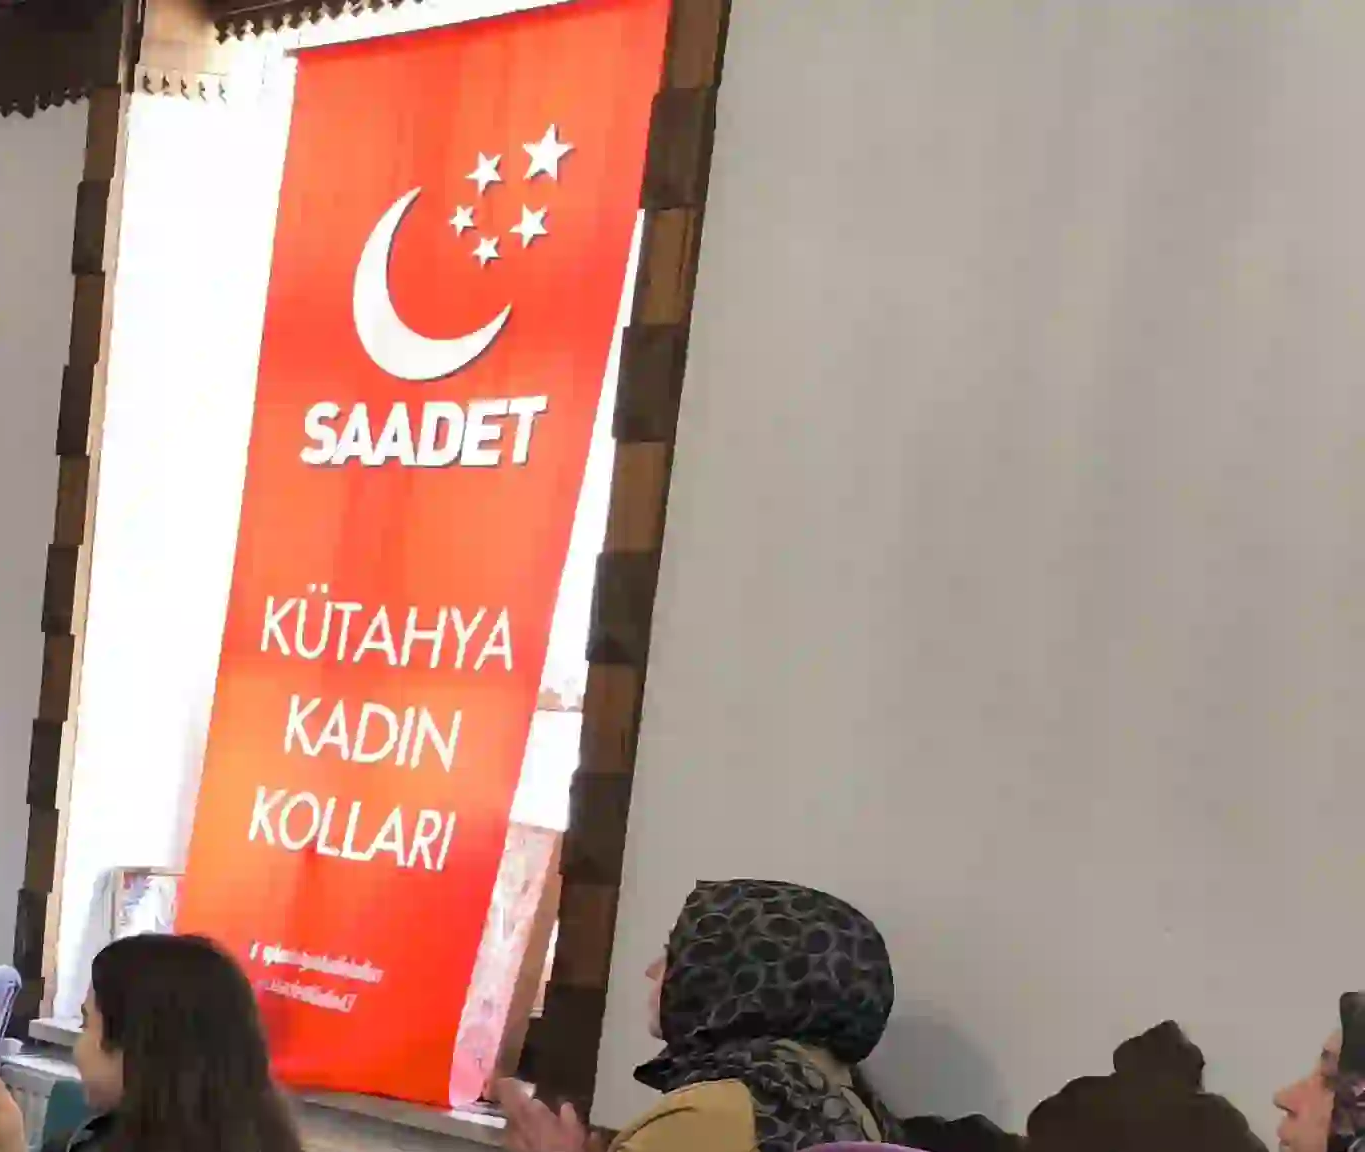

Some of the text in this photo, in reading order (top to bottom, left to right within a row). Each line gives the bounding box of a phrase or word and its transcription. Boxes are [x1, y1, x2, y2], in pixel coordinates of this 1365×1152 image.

[300, 395, 548, 467] SAADET
[260, 583, 513, 671] KÜTAHYA
[284, 694, 462, 773] KADIN
[248, 785, 456, 872] KOLLARI
